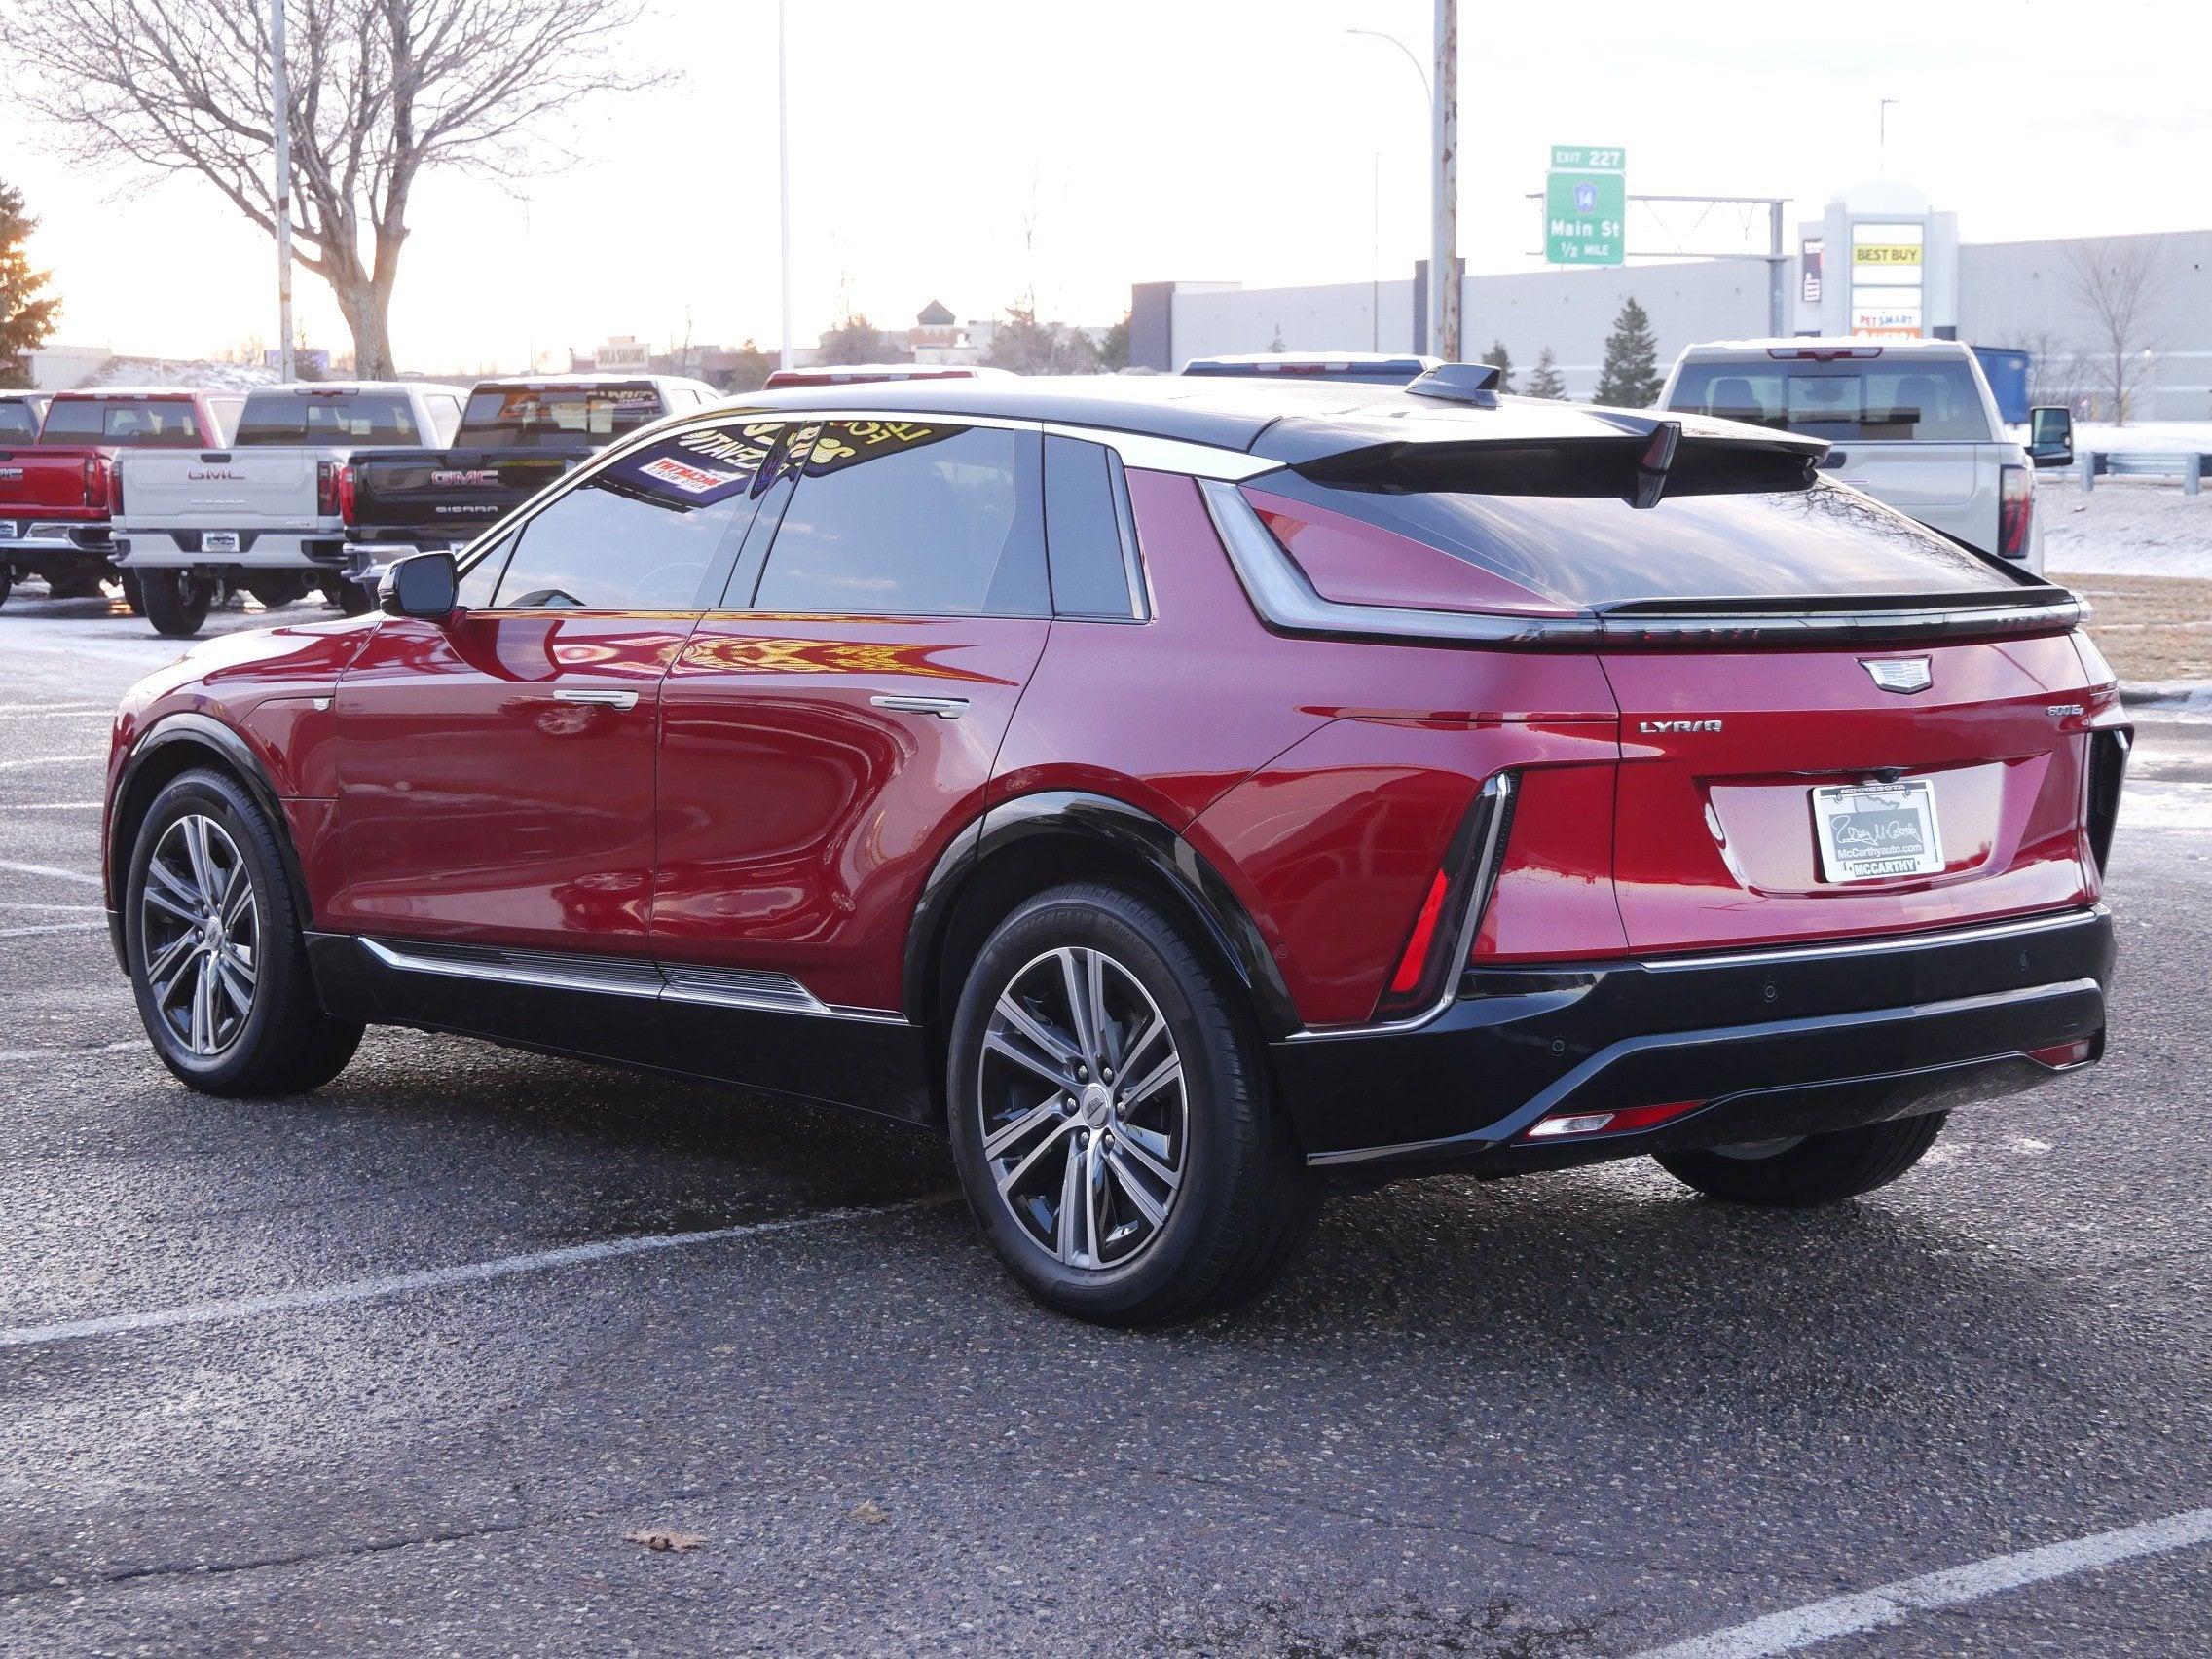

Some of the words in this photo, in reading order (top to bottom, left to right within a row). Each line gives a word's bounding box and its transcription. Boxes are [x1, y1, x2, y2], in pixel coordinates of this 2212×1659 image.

[1556, 151, 1581, 164] EXIT
[1589, 151, 1620, 166] 227
[1579, 191, 1593, 206] 14
[1551, 219, 1593, 237] Main
[1602, 219, 1620, 238] St
[1584, 244, 1609, 256] MILE
[1858, 249, 1888, 260] BEST
[1892, 249, 1916, 260] BUY
[188, 467, 246, 480] GMC
[431, 470, 498, 485] GMC
[1640, 720, 1722, 733] LYRIQ
[1840, 784, 1906, 794] MINNESOTA
[1837, 843, 1922, 859] McCarthyauto.com
[1854, 859, 1915, 875] MCCARTHY
